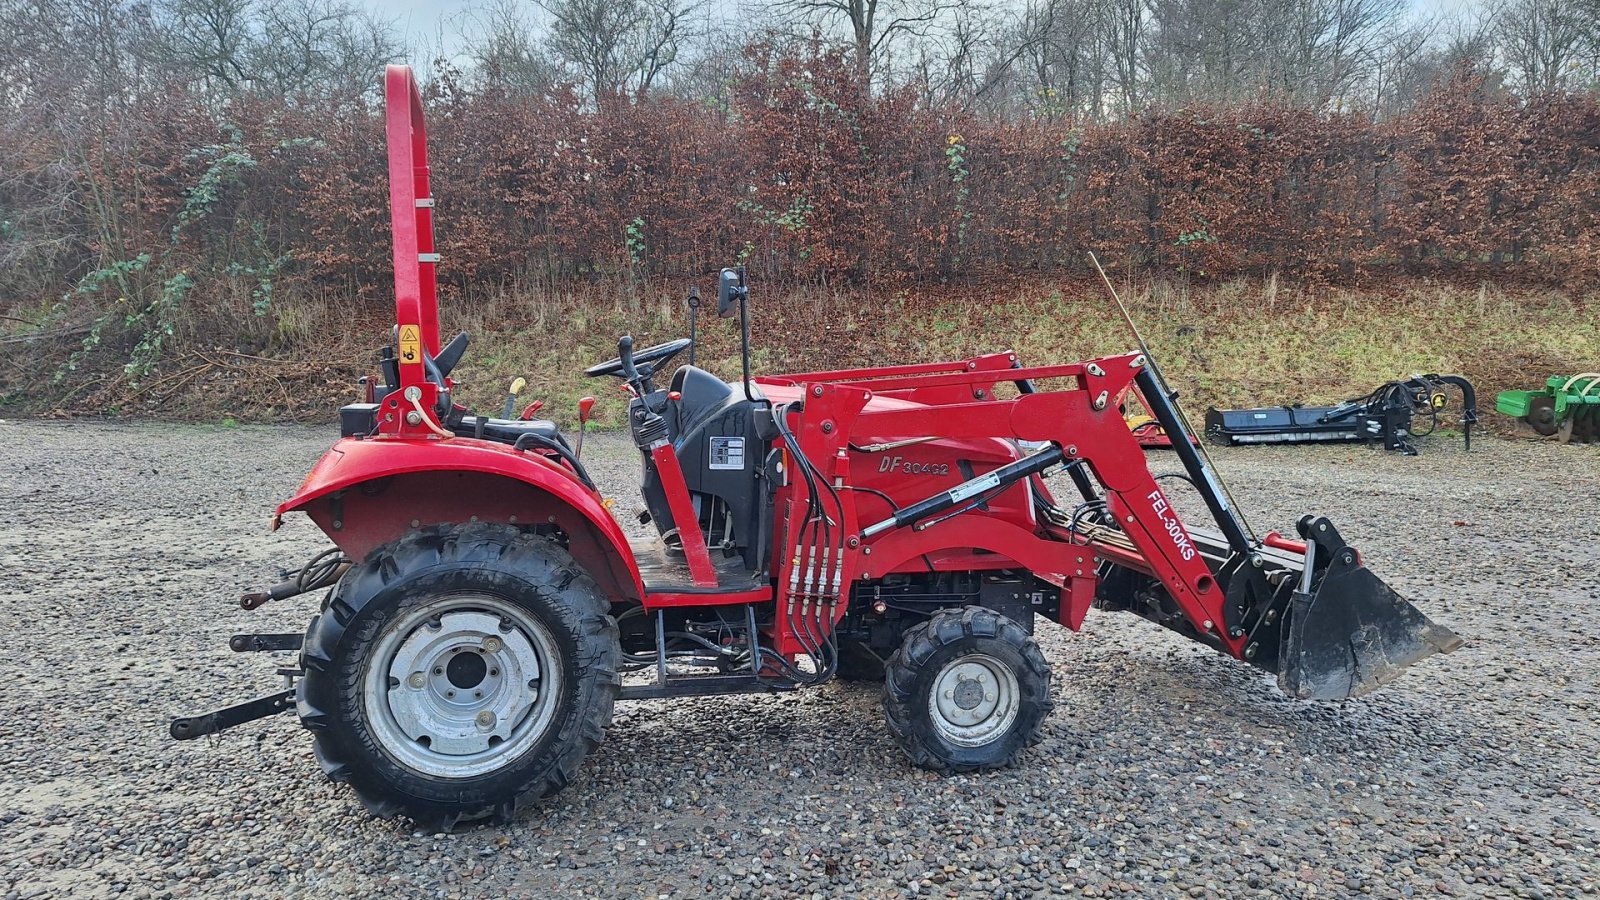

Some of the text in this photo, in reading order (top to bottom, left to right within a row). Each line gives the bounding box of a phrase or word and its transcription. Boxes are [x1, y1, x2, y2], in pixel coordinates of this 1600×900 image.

[879, 456, 949, 476] DF 304G2
[1147, 490, 1195, 561] FEL-300KS
